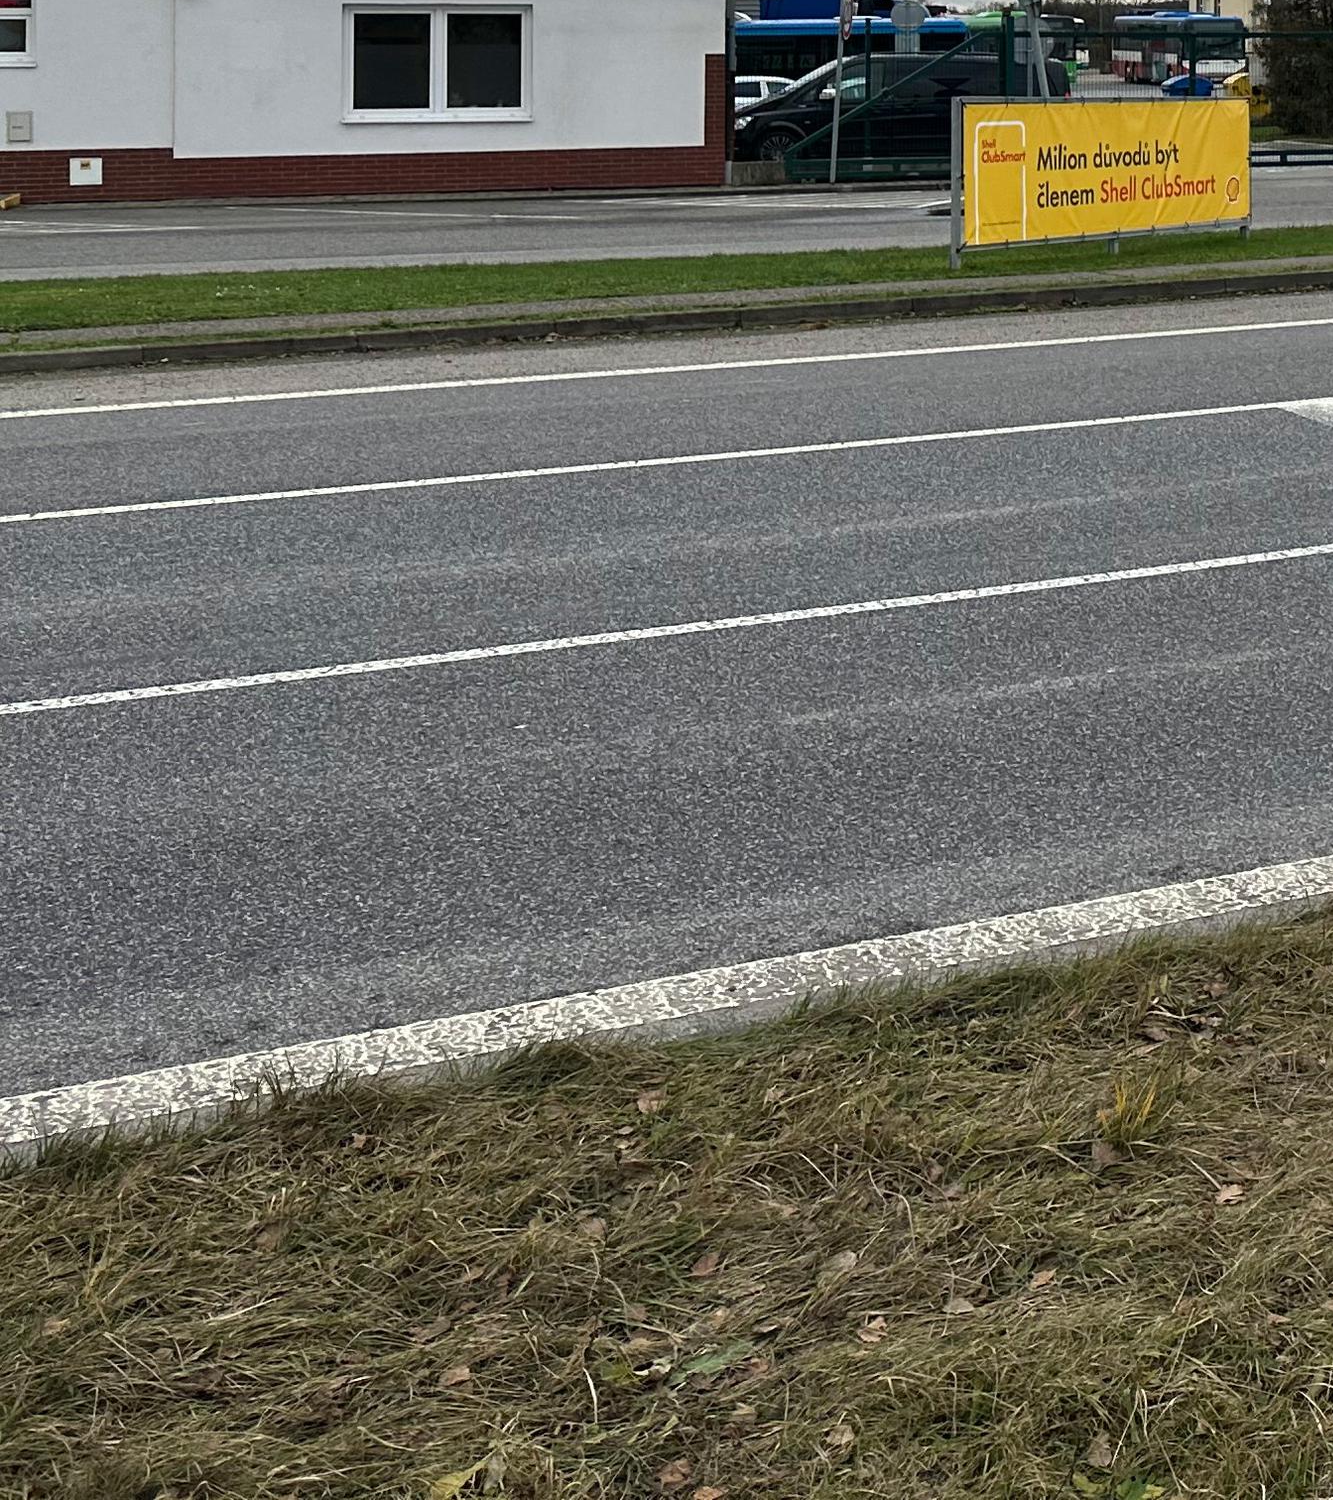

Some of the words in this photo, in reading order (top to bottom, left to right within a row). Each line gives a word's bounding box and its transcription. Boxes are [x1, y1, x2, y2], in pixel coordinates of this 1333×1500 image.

[982, 150, 1026, 163] ClubSmart
[1037, 144, 1087, 171] Milion
[1093, 140, 1150, 168] důvodů
[1155, 139, 1179, 171] být
[1037, 183, 1095, 208] členem
[1100, 175, 1136, 203] Shell
[1141, 175, 1216, 200] ClubSmart
